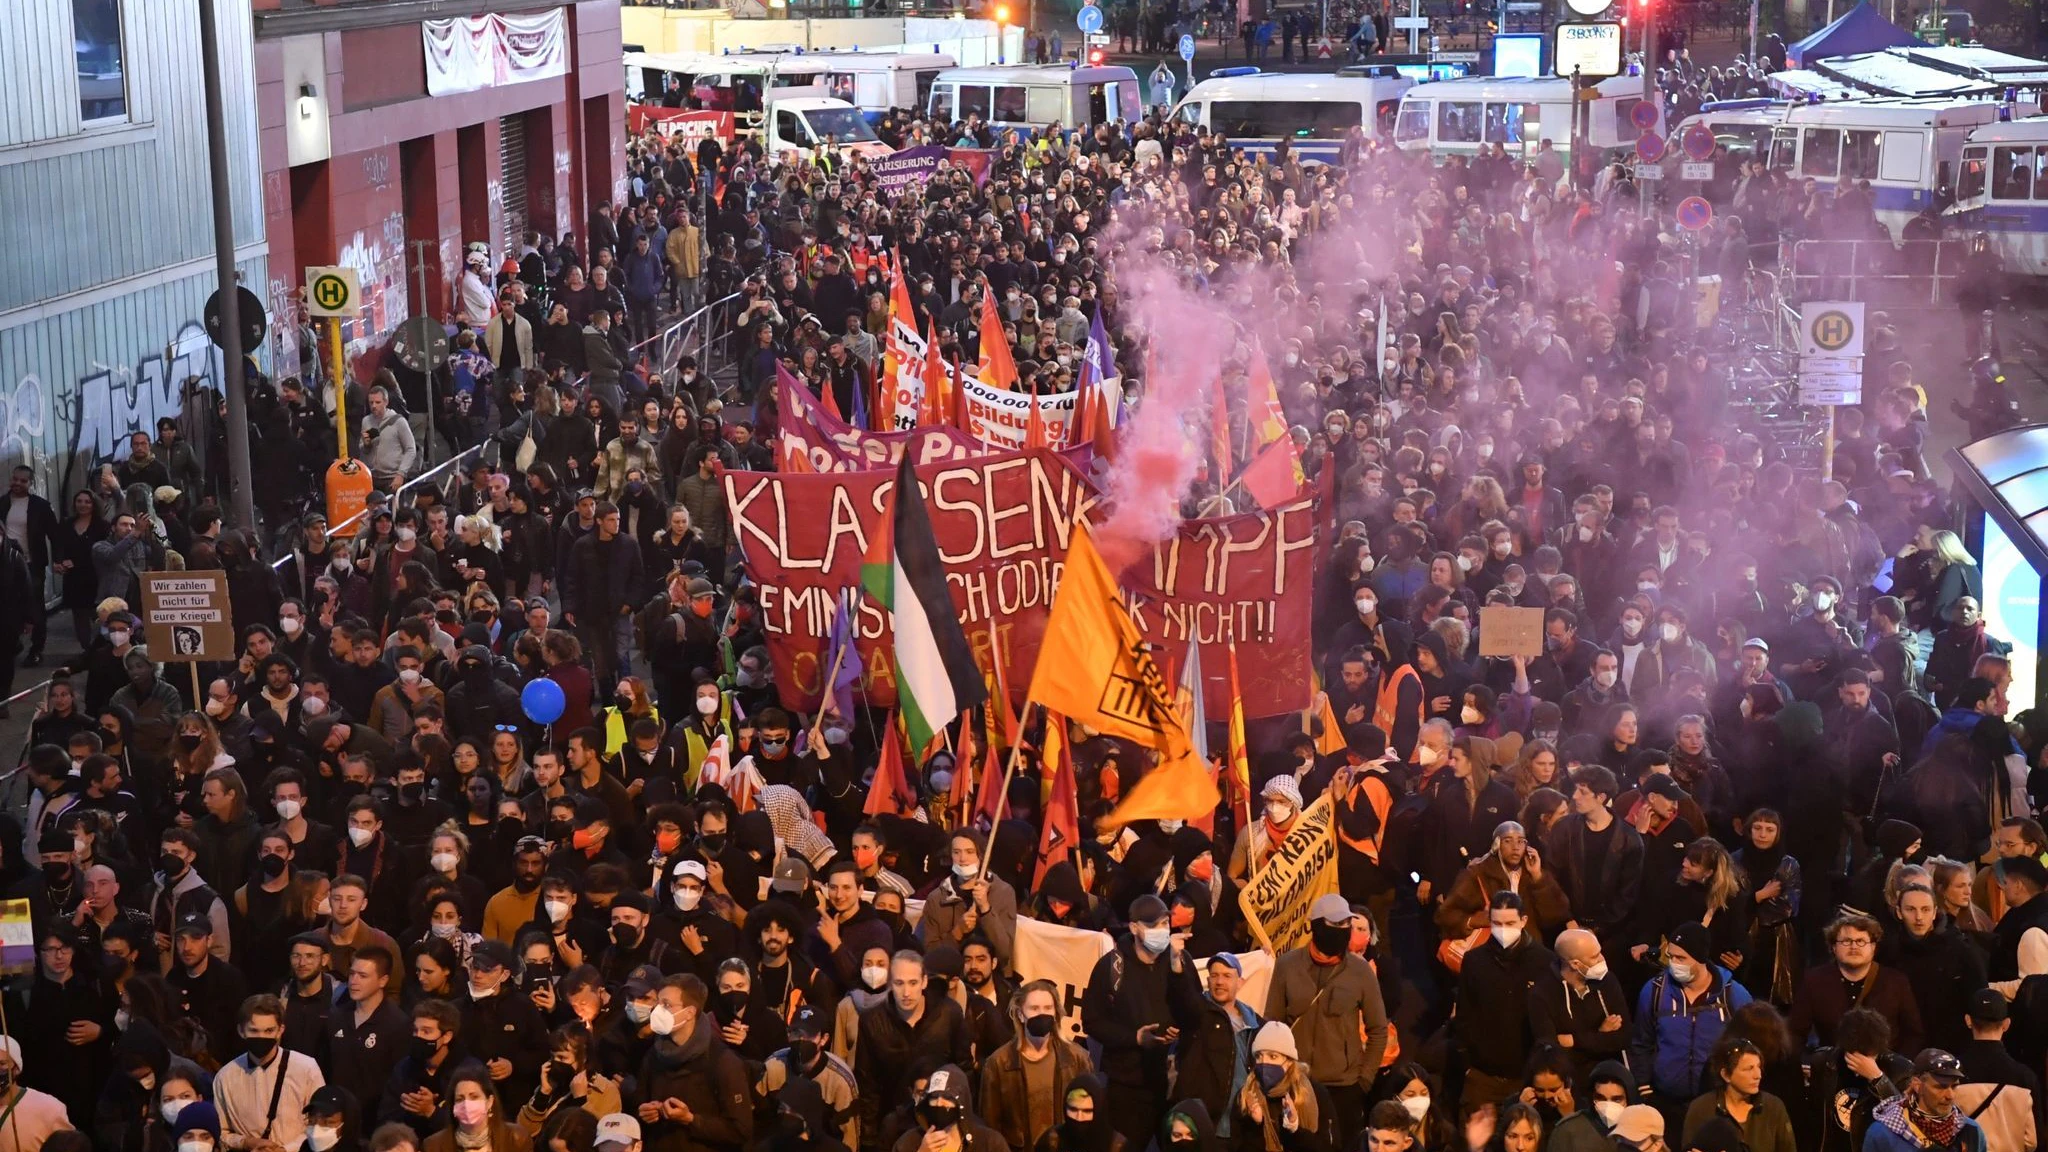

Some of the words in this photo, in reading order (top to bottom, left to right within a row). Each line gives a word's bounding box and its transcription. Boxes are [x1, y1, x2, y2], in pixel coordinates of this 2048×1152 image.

[322, 283, 339, 302] H
[1823, 320, 1842, 341] H
[724, 457, 1315, 597] KLASENKMPF
[154, 582, 170, 591] Wir
[175, 581, 206, 590] zahlen
[162, 597, 187, 606] nicht
[191, 596, 205, 605] für
[752, 570, 990, 639] EMINISCH
[1163, 600, 1276, 645] NICHT!!
[153, 613, 175, 621] eure
[180, 612, 215, 622] Kriege!
[1281, 822, 1324, 866] KEIN
